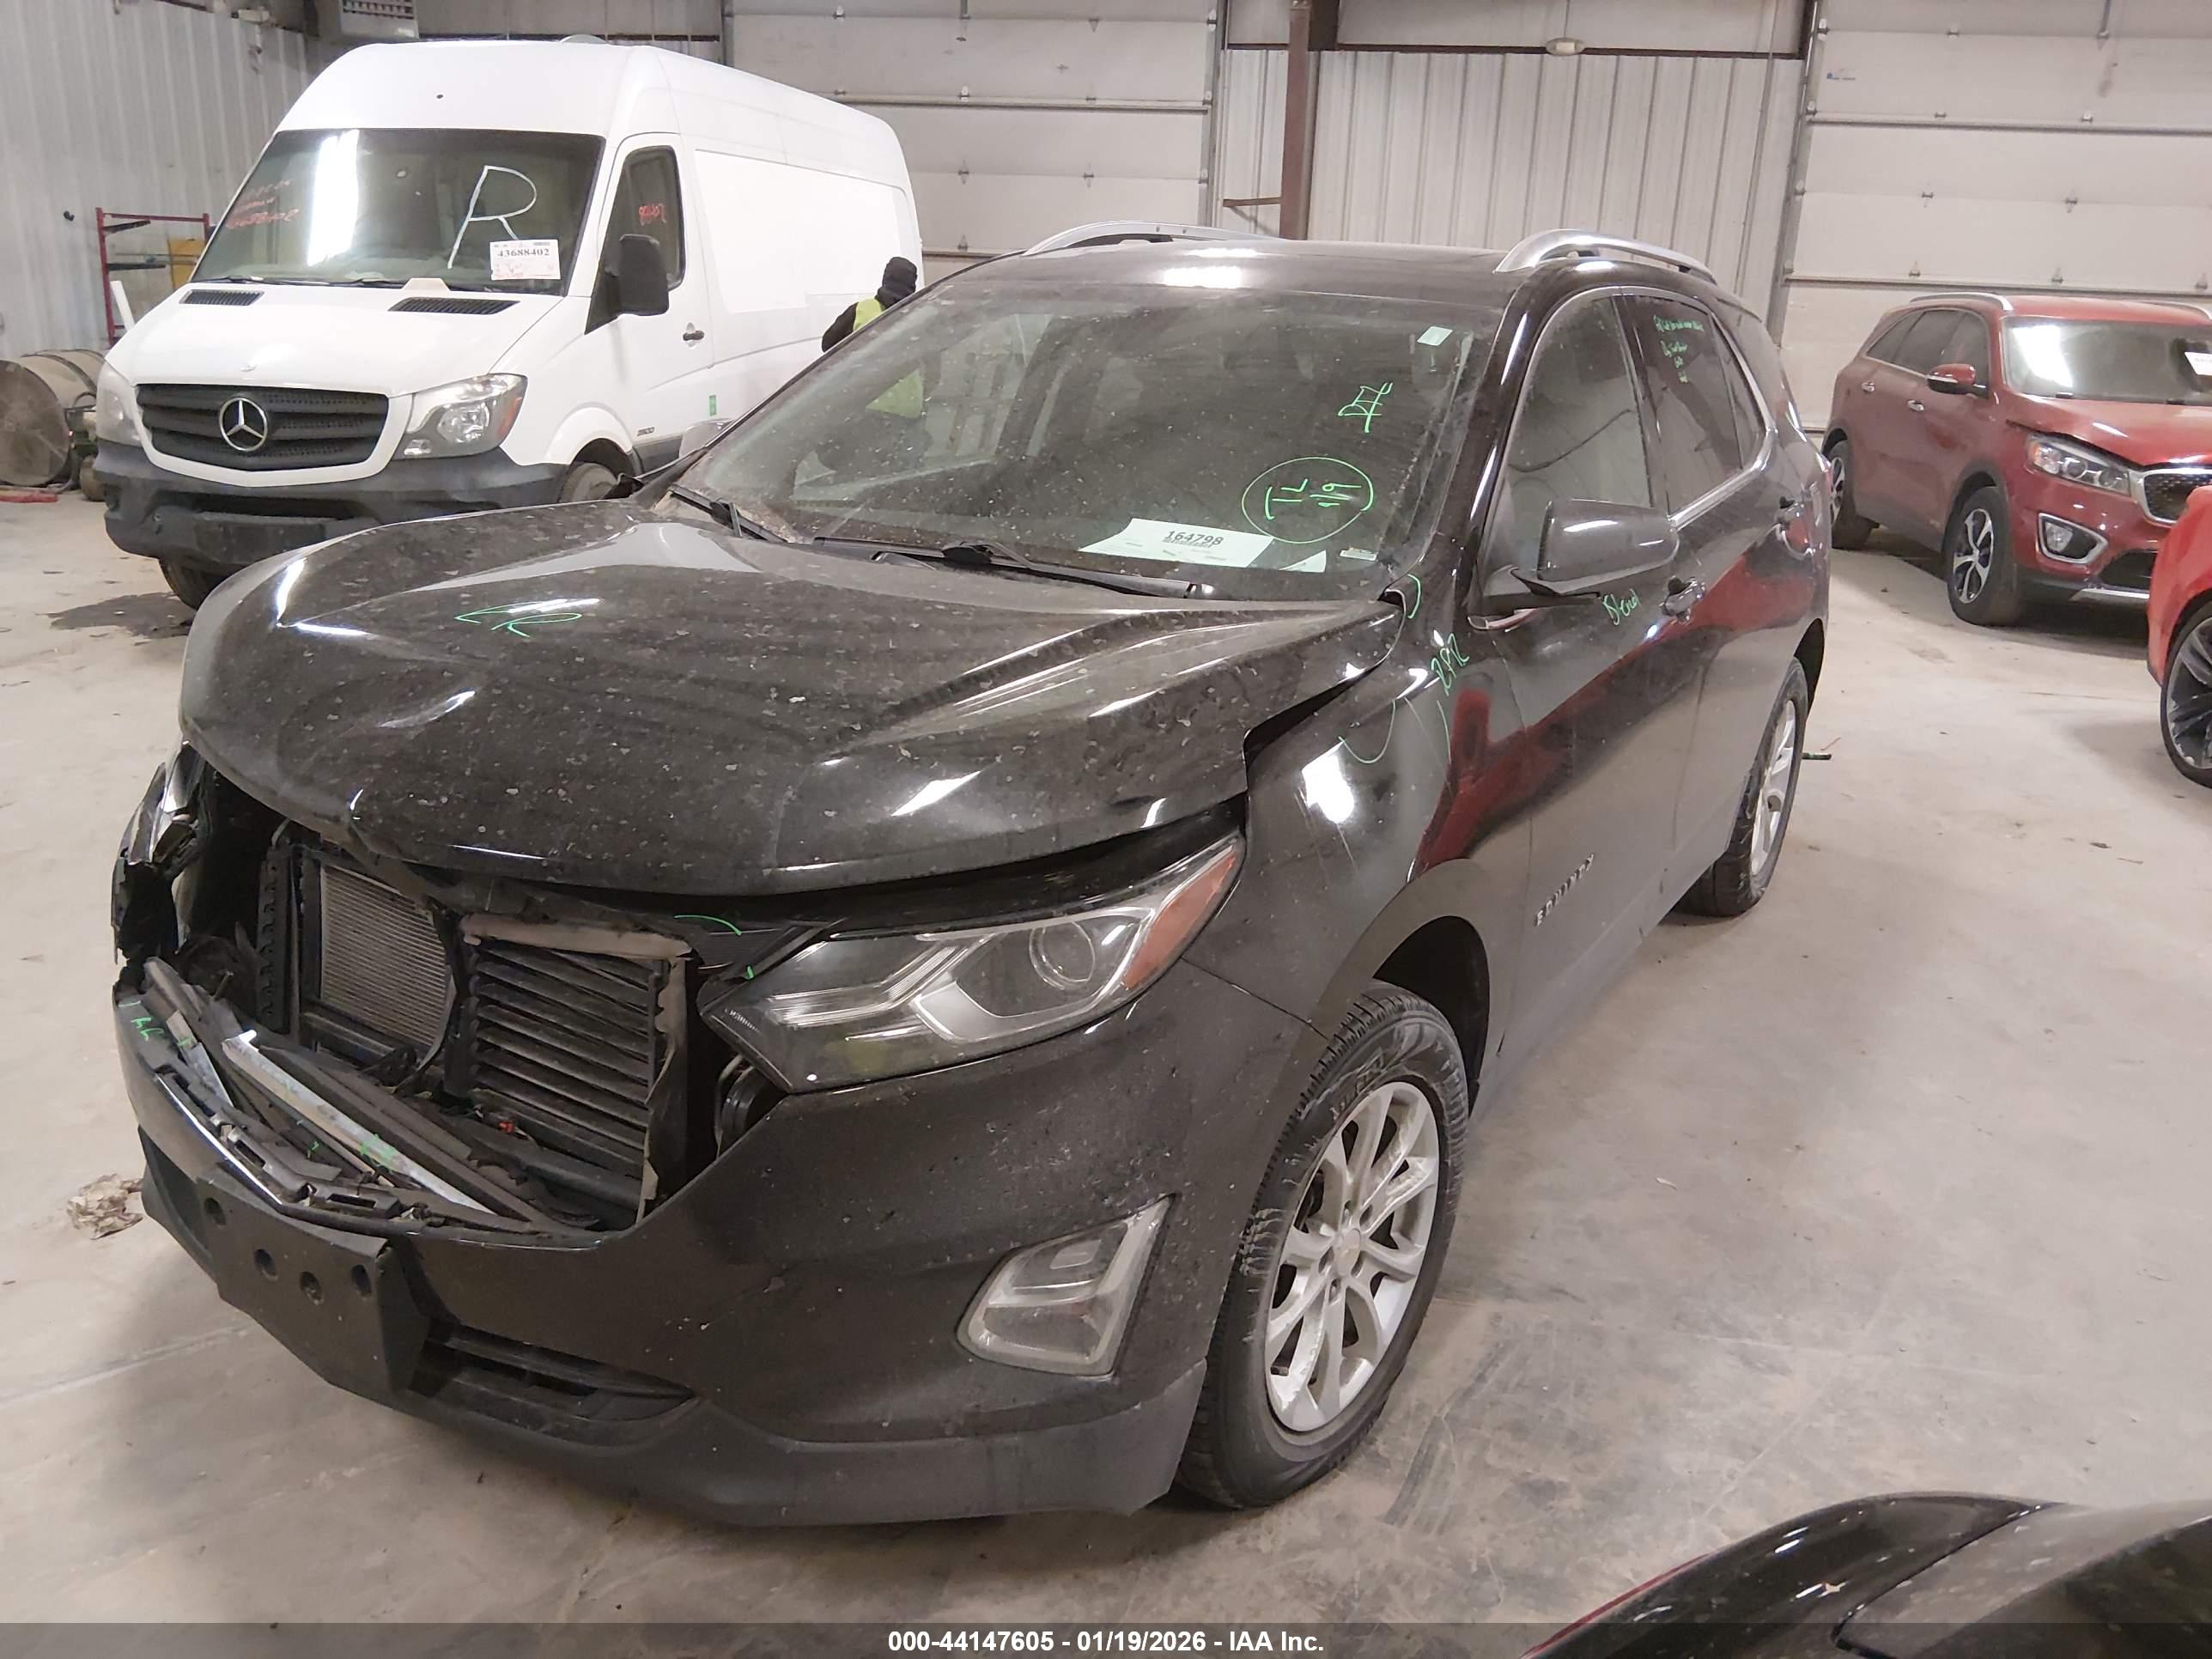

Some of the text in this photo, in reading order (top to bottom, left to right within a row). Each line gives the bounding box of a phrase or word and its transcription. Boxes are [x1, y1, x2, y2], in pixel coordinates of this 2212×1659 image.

[447, 165, 537, 270] R
[498, 248, 550, 258] 43688402
[1165, 530, 1224, 546] 164798
